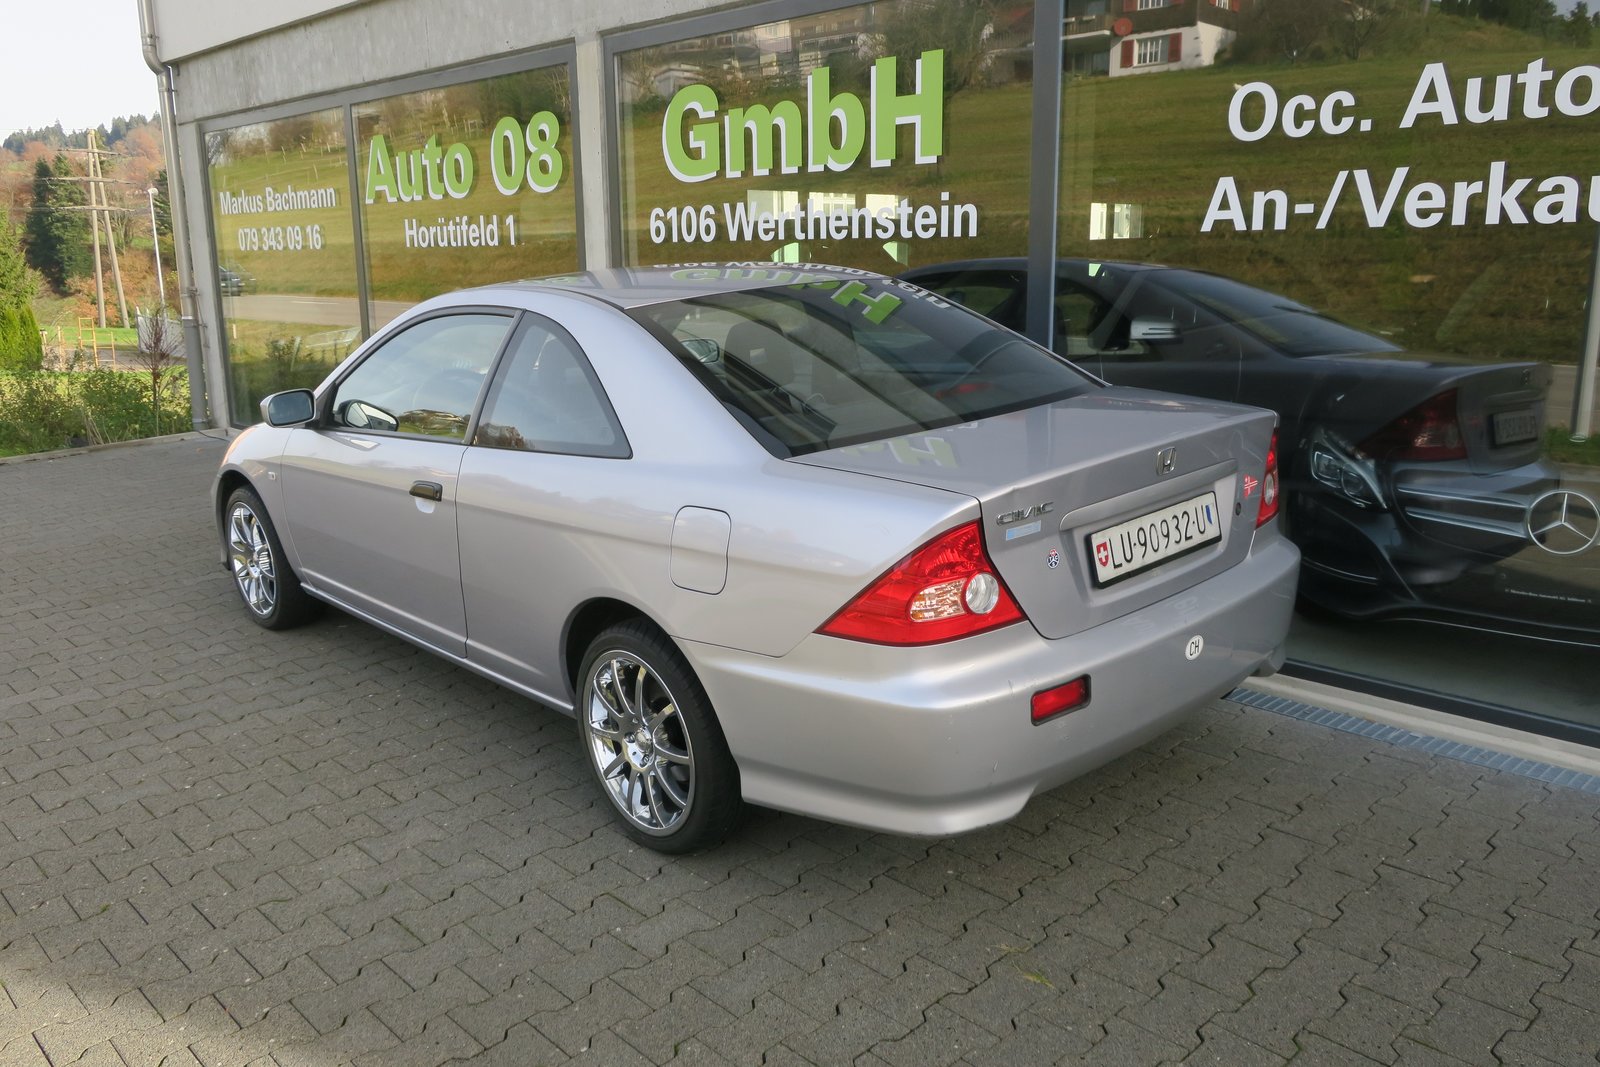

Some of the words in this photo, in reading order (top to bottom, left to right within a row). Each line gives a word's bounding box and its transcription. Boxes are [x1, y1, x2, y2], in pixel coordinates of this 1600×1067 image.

[662, 49, 944, 183] GmbH
[1228, 81, 1372, 142] Occ.
[1399, 58, 1600, 129] Auto
[365, 136, 474, 205] Auto
[490, 110, 564, 196] 08
[219, 190, 263, 215] Markus
[266, 186, 336, 212] Bachmann
[650, 205, 717, 244] 6106
[723, 191, 978, 242] Werthenstein
[239, 228, 259, 252] 079
[262, 227, 283, 251] 343
[287, 226, 304, 250] 09
[307, 225, 321, 249] 16
[404, 215, 498, 247] Horütifeld
[505, 214, 516, 246] 1
[996, 501, 1054, 525] CIVIC
